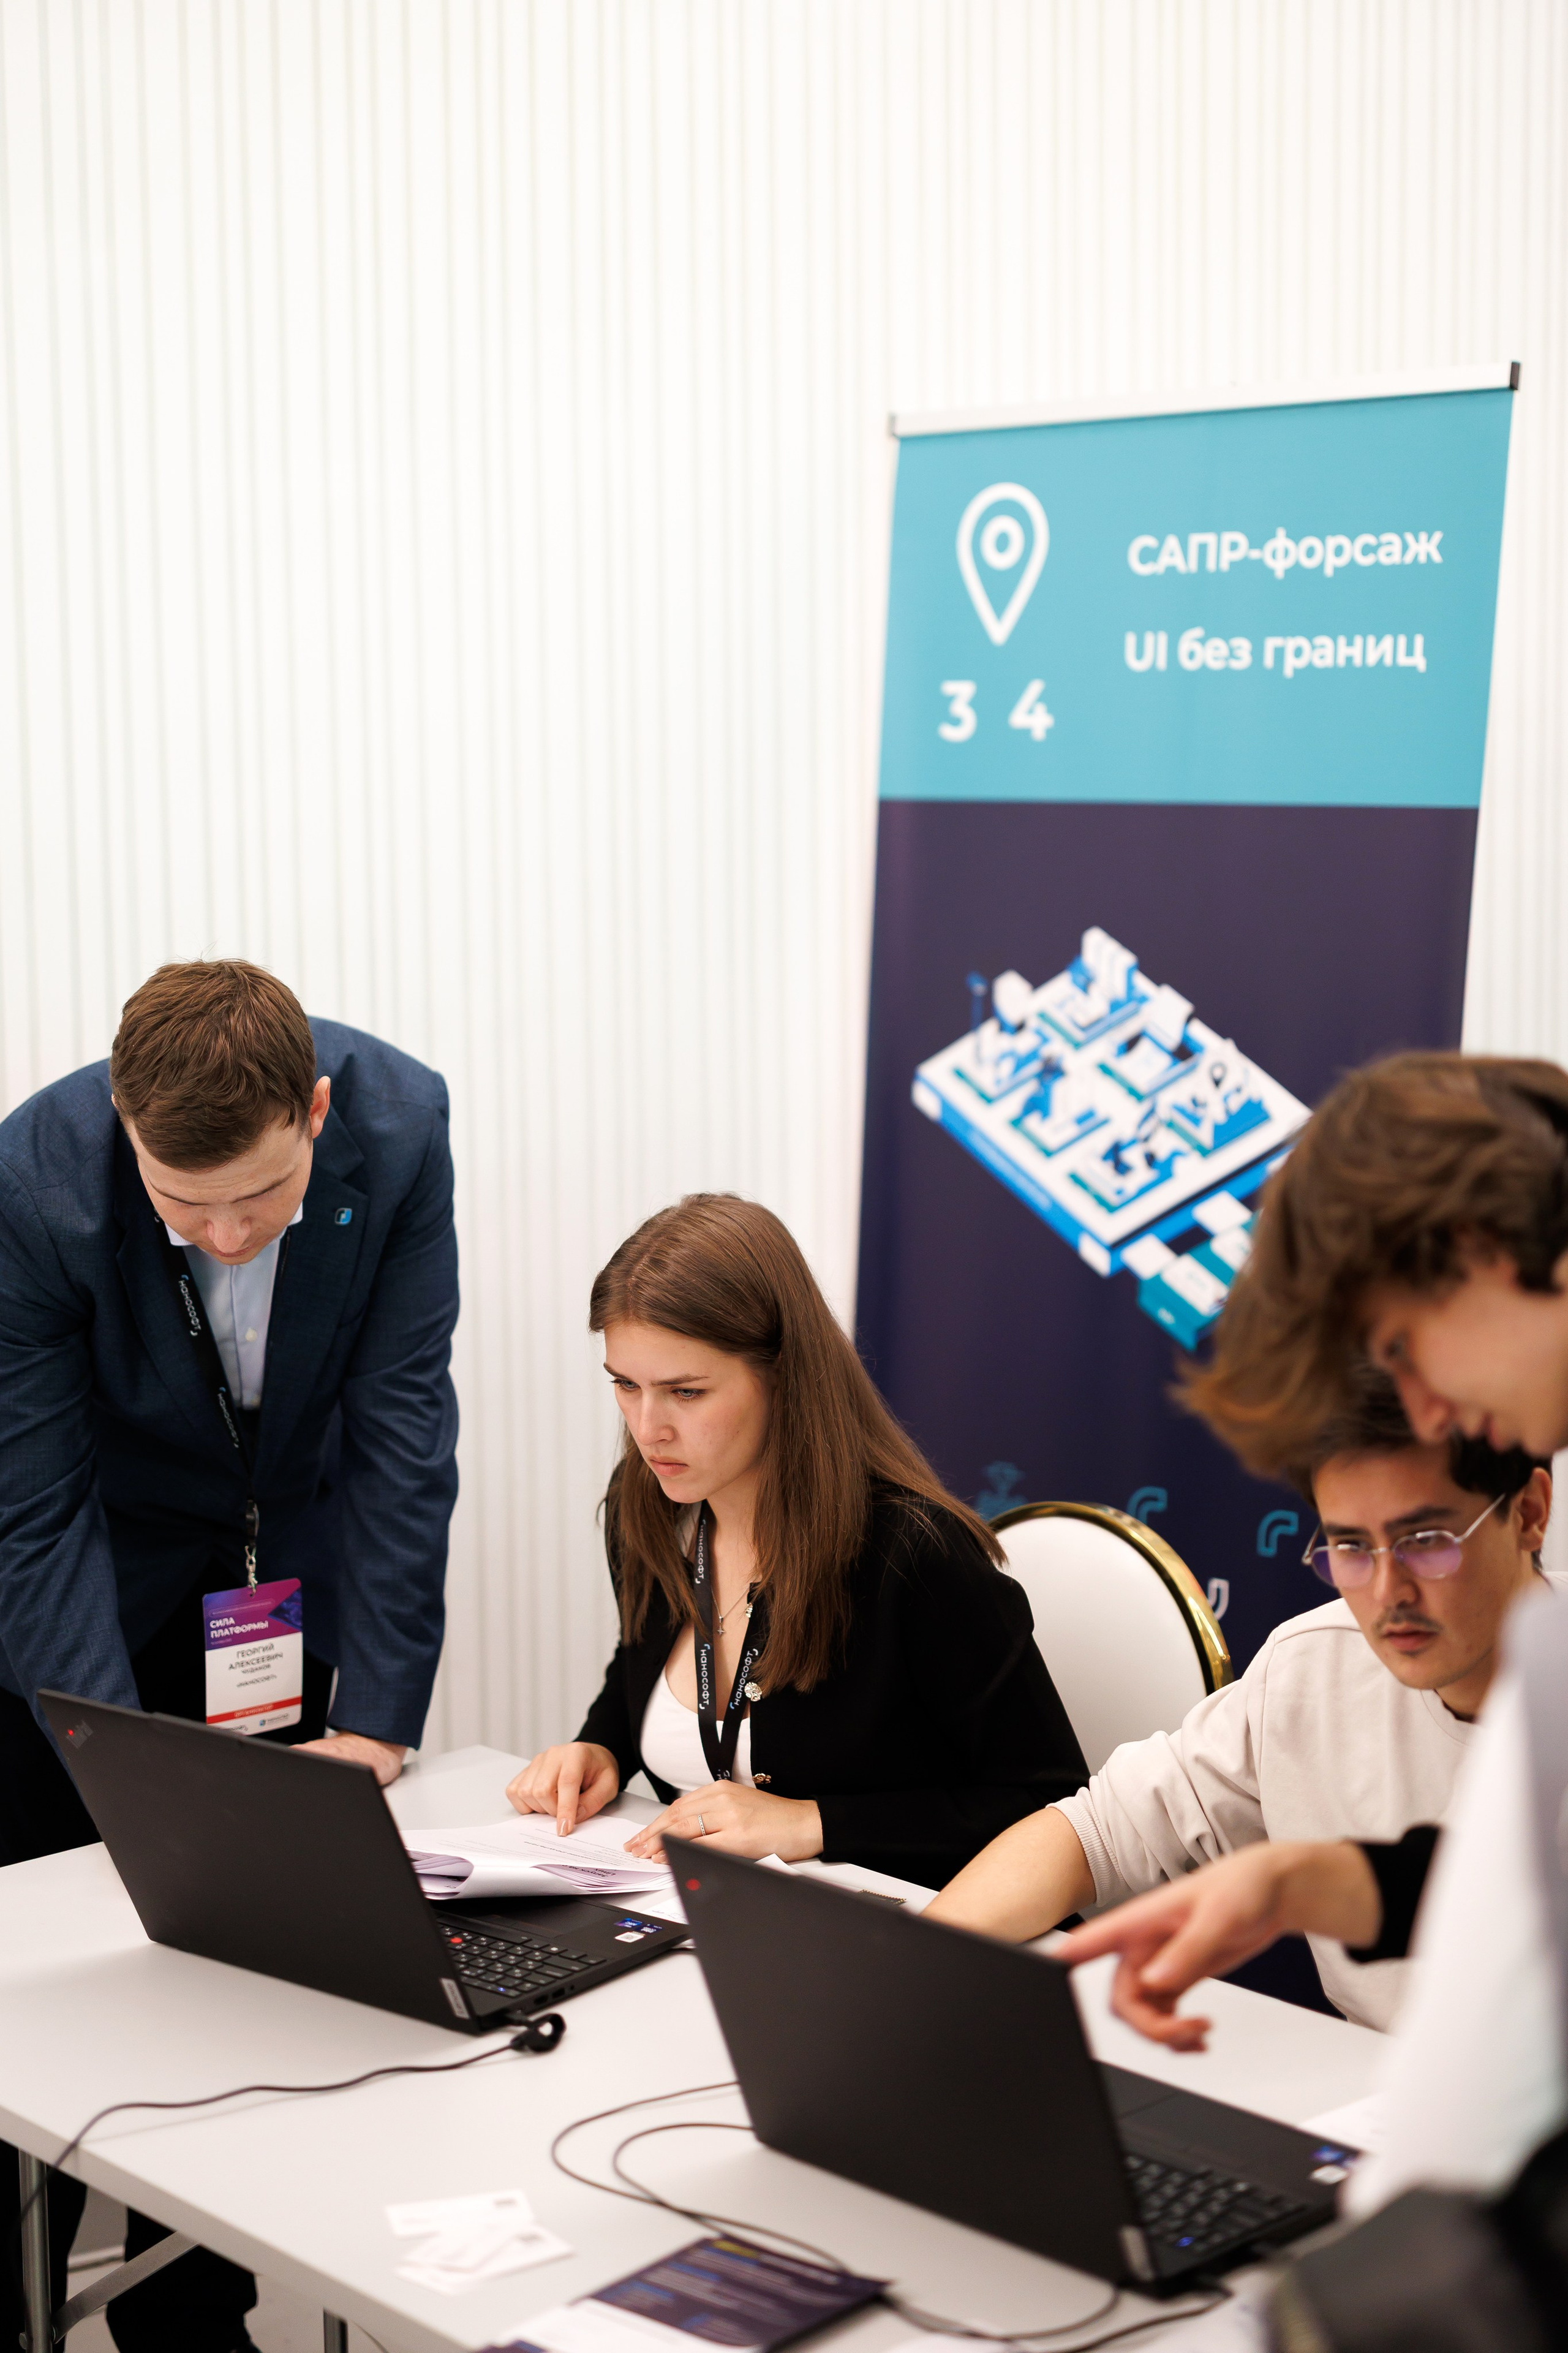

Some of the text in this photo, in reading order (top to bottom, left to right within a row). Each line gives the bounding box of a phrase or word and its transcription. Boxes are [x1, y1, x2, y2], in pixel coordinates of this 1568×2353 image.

[1128, 527, 1444, 580] САПР-форсаж
[1124, 626, 1427, 679] UI без границ
[938, 678, 1055, 743] 3 4
[209, 1617, 235, 1629] СИЛА
[210, 1621, 269, 1639] ПЛАТФОРМЫ
[236, 1642, 275, 1659] ГЕОРГИЙ
[700, 1649, 710, 1705] нанософт
[734, 1650, 753, 1706] нанософт
